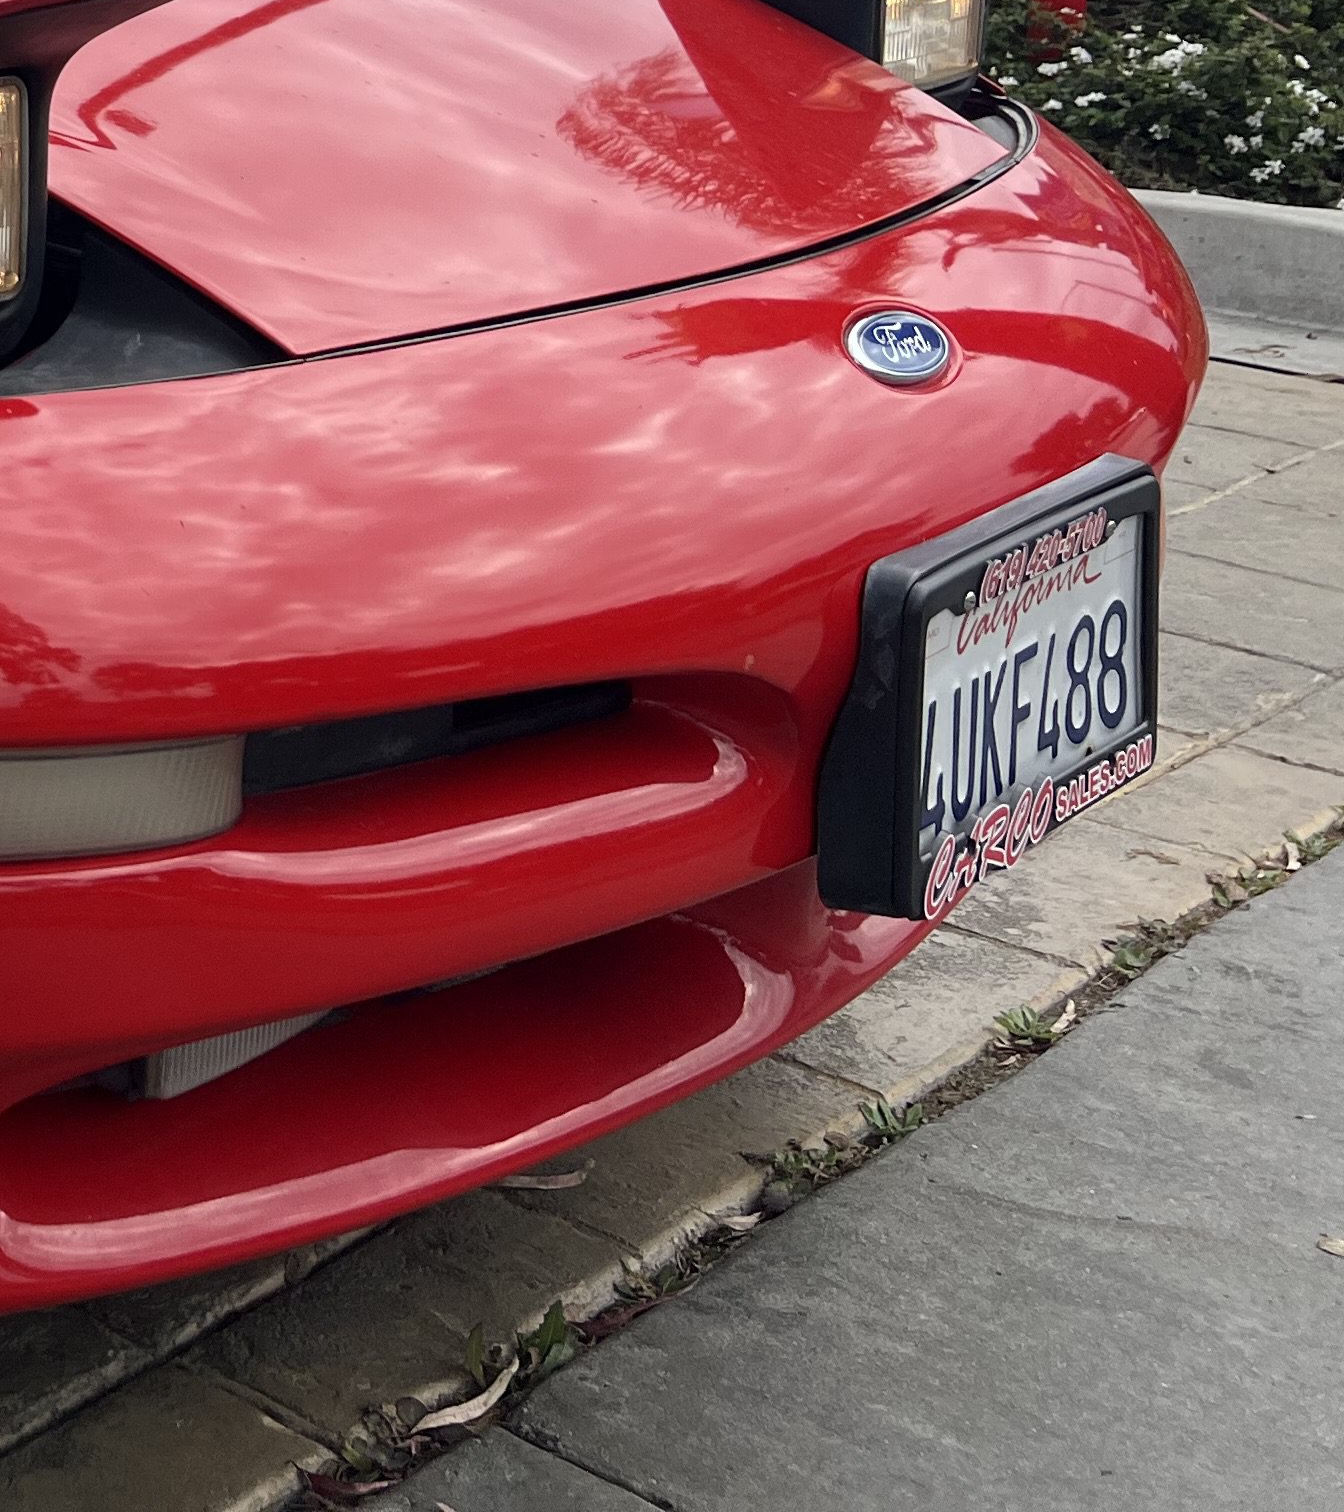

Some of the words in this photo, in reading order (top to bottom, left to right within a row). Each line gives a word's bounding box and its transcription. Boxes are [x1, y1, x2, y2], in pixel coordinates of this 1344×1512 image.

[873, 321, 932, 364] Ford
[957, 554, 1102, 656] California
[979, 543, 1029, 607] (619)
[1027, 506, 1108, 580] 420-5700
[920, 599, 1128, 837] 4UKF488
[924, 775, 1054, 920] CARCO
[1055, 733, 1153, 822] SALES.COM
